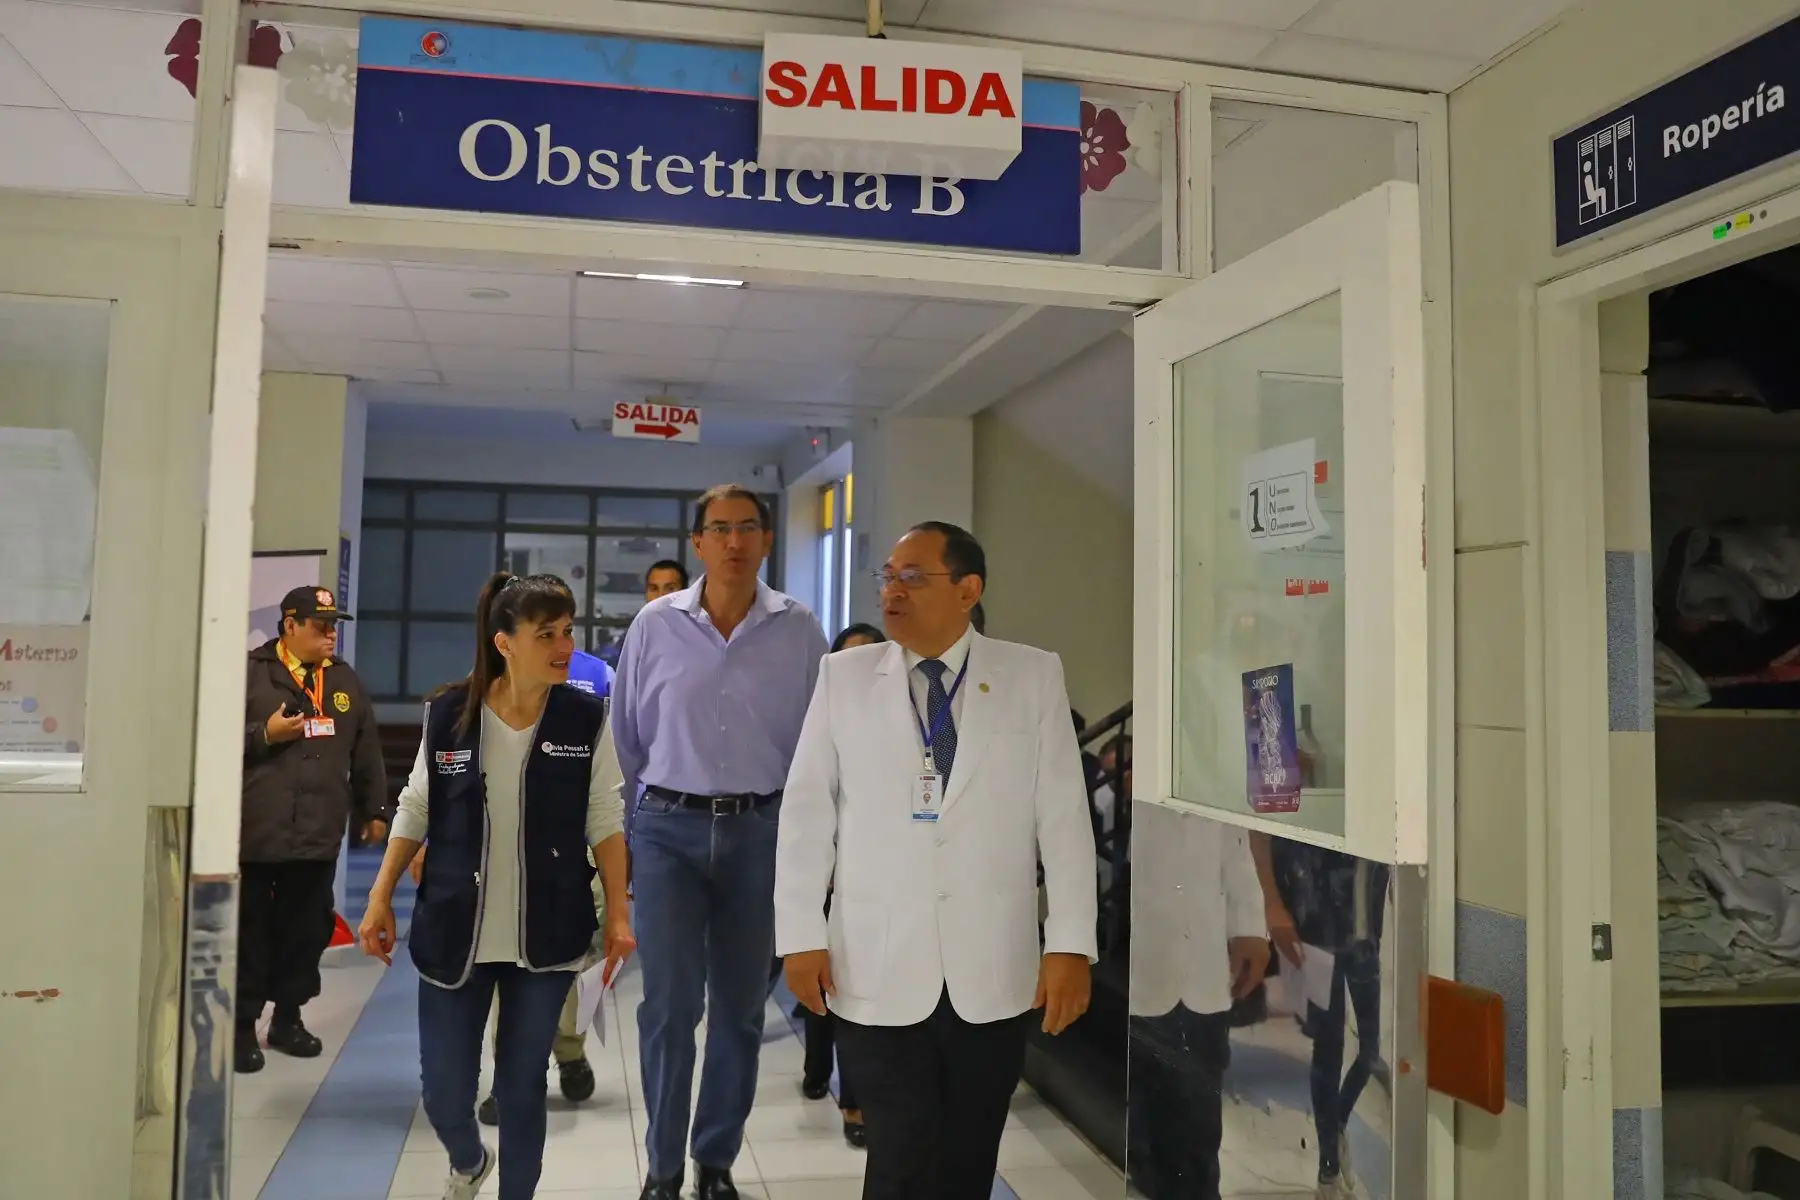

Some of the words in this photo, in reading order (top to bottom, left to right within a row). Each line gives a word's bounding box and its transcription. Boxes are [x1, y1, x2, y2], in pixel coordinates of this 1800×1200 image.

[765, 61, 1016, 118] SALIDA
[1663, 82, 1785, 158] Ropería
[458, 118, 893, 211] Obstetricia
[912, 175, 965, 216] B
[615, 403, 699, 425] SALIDA
